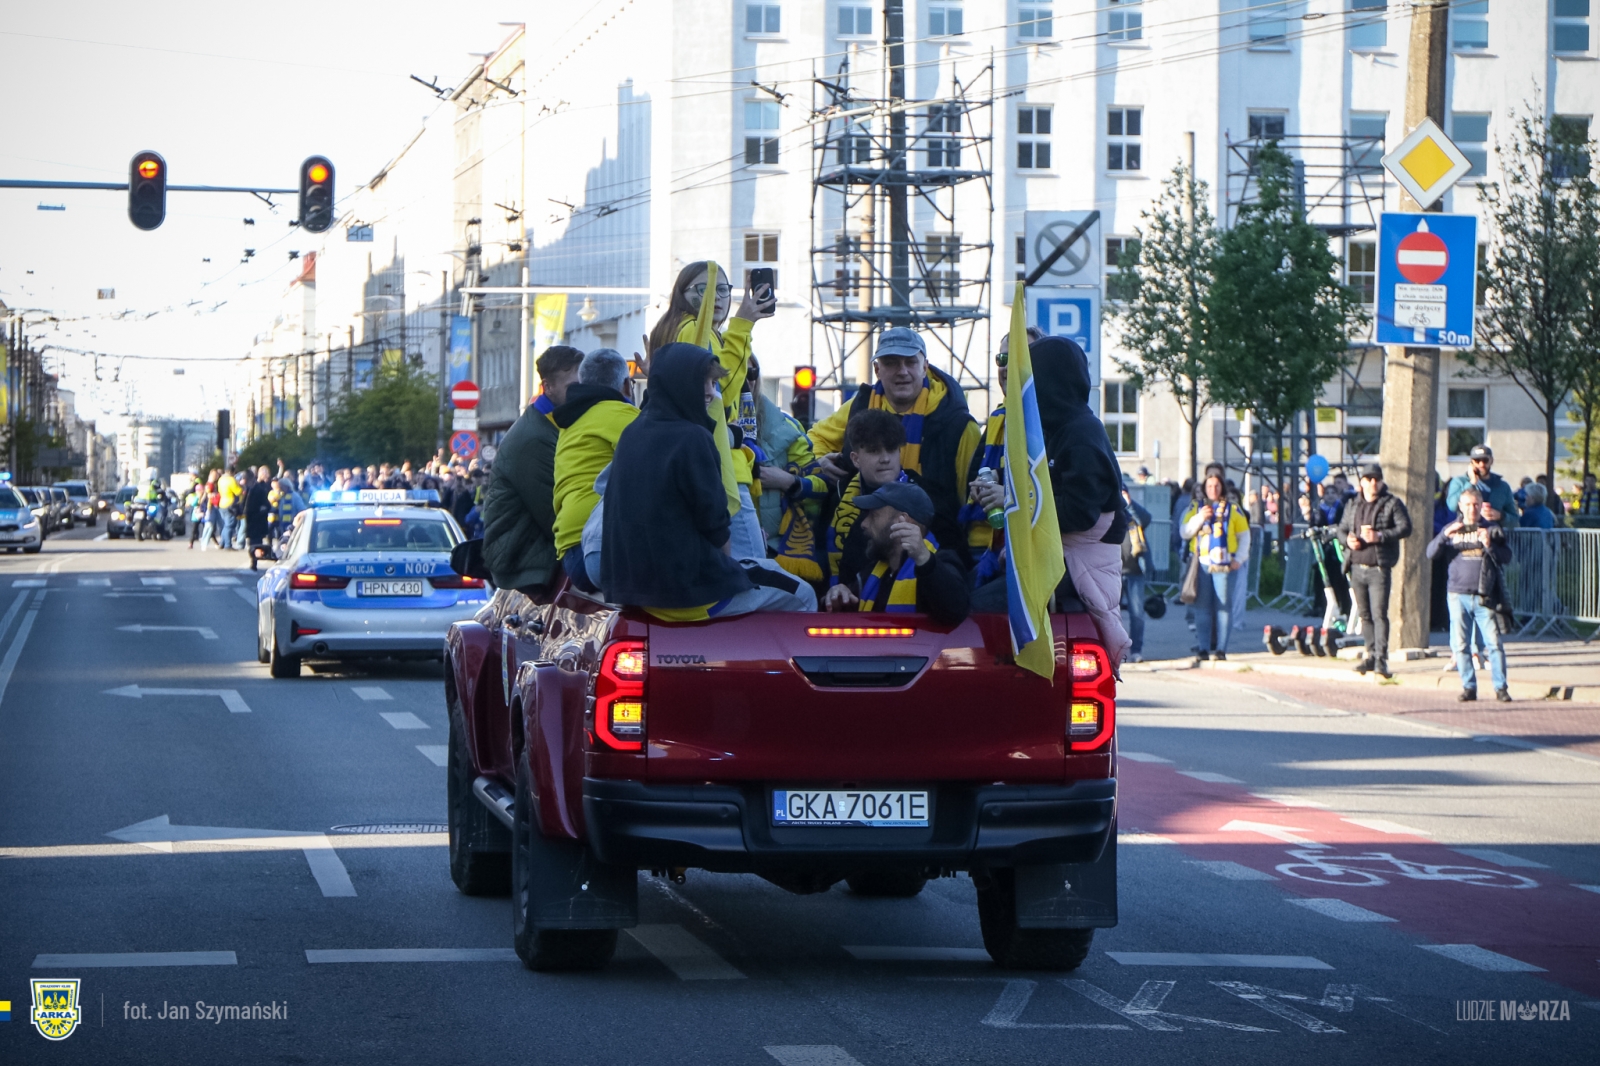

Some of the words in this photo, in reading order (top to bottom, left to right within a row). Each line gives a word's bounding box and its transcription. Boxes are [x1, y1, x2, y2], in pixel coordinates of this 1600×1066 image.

[1414, 304, 1441, 312] dotyczy
[1437, 330, 1470, 345] 50m
[739, 417, 756, 425] ARK
[362, 492, 402, 501] POLICJA
[346, 565, 375, 574] POLICJA
[364, 583, 389, 594] HPN
[392, 583, 420, 594] C430
[656, 654, 706, 664] TOYOTA
[788, 793, 837, 819] GKA
[846, 793, 925, 819] 7061E
[775, 809, 786, 817] PL
